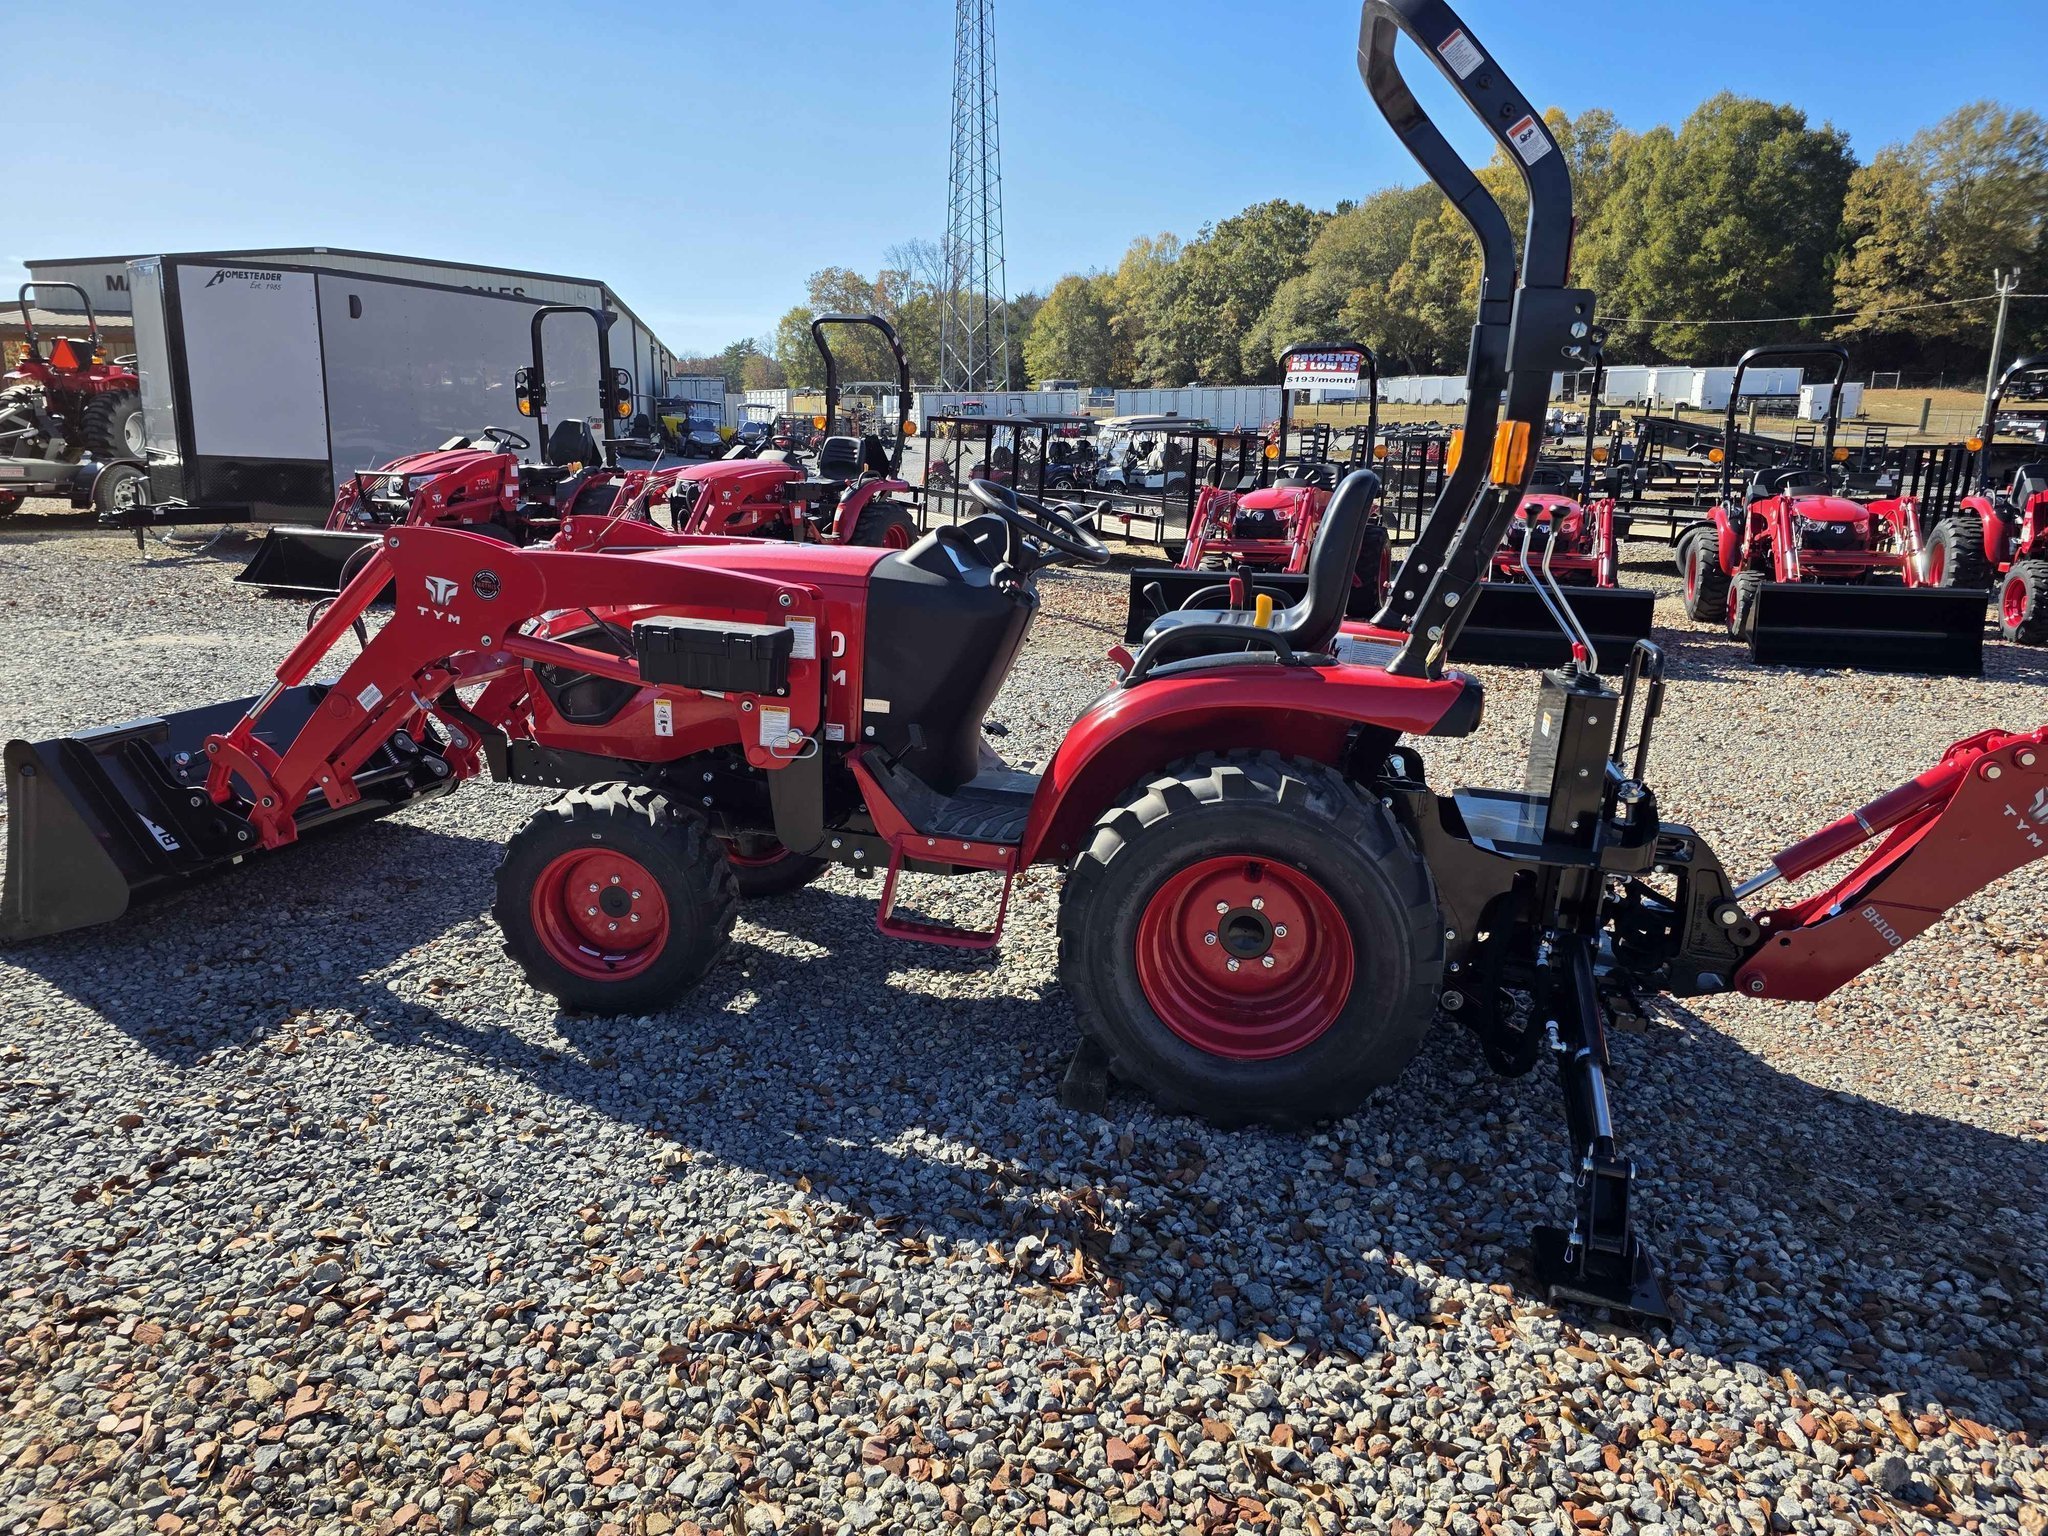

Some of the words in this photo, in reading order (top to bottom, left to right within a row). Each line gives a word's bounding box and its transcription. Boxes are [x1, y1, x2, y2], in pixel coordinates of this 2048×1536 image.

[106, 275, 130, 291] M
[205, 269, 282, 288] HOMESTEADER
[265, 283, 282, 291] 1985
[1291, 361, 1308, 371] AS
[1309, 361, 1338, 371] LOW
[1340, 362, 1358, 371] AS
[1292, 353, 1361, 363] PAYMENTS
[1286, 375, 1356, 384] $193/month
[416, 605, 461, 625] TYM
[2003, 803, 2044, 848] TYM
[1861, 905, 1903, 948] BH100
